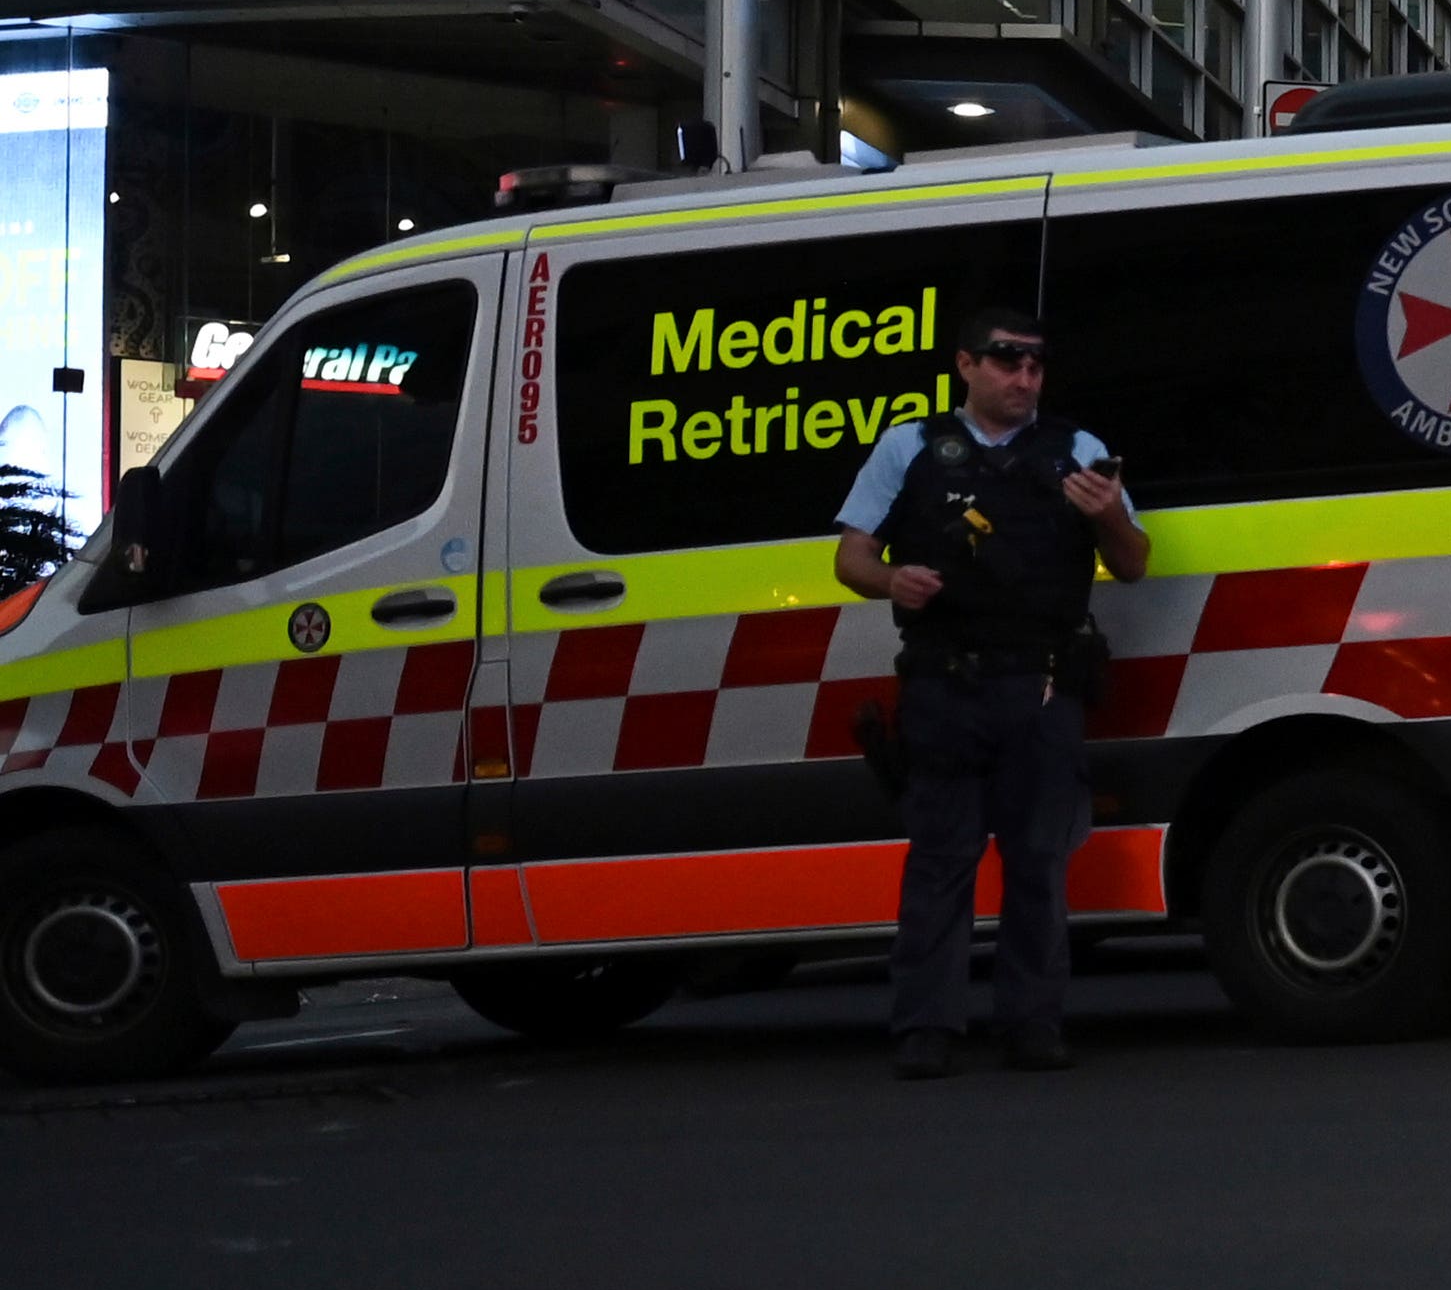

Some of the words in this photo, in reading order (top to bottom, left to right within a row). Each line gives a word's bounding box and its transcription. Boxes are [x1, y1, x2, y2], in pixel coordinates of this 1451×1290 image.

[1366, 224, 1422, 296] NEW
[517, 251, 550, 445] AERO95
[649, 286, 937, 377] Medical
[138, 392, 174, 404] GEAR
